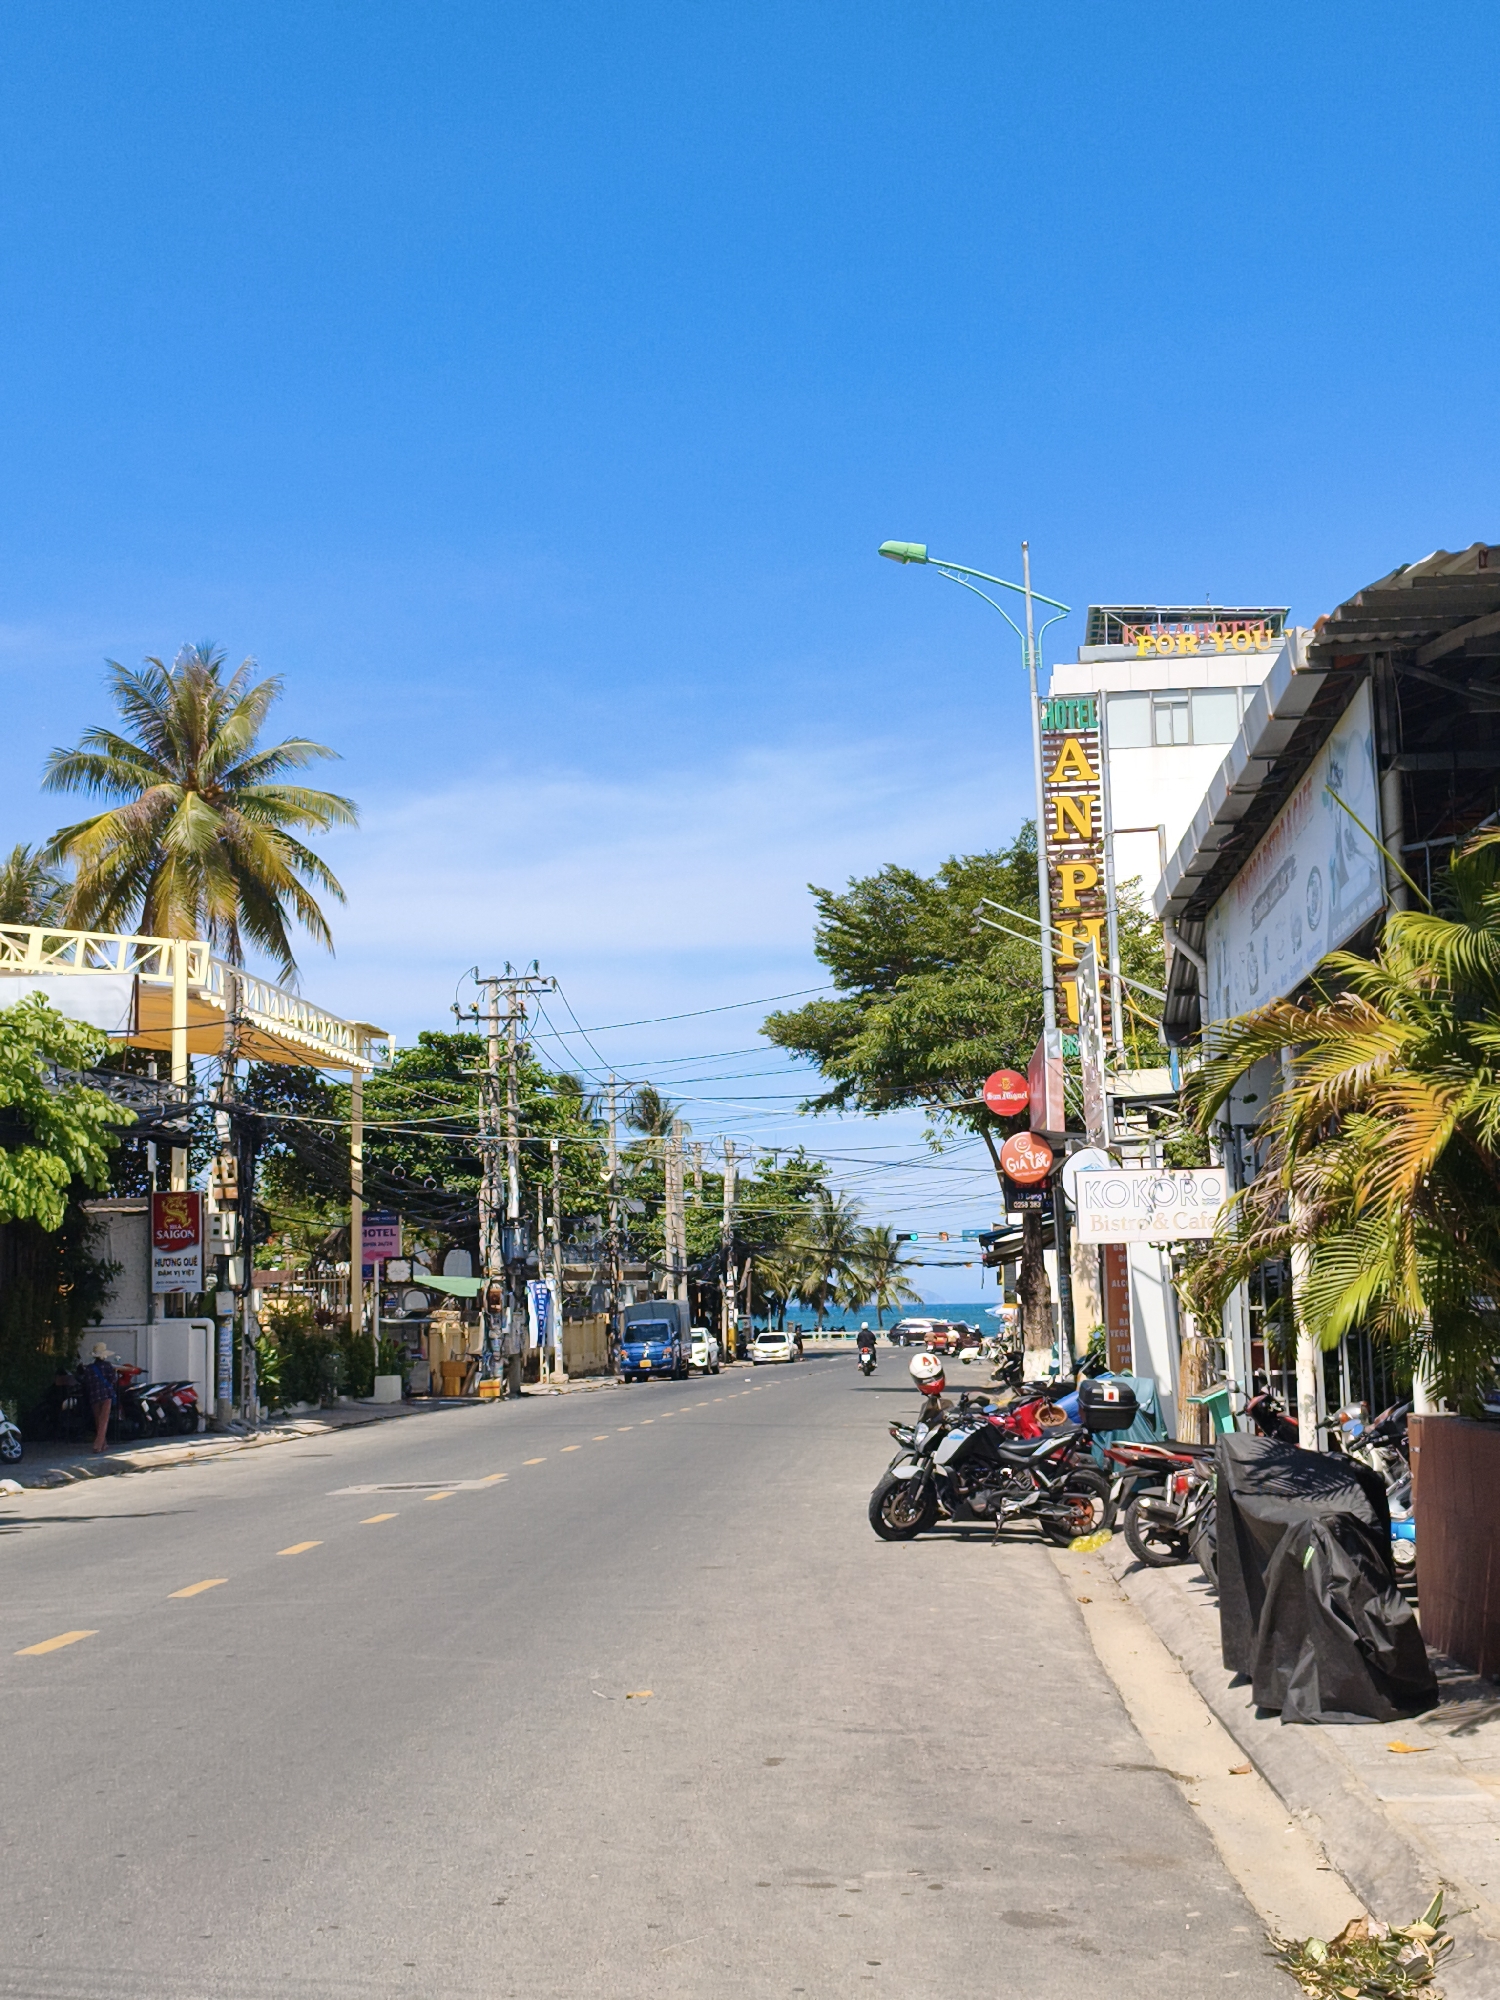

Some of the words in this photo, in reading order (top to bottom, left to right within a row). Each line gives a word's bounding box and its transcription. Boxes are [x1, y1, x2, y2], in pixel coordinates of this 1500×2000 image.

[1136, 634, 1200, 656] FOR
[1209, 629, 1273, 653] YOU
[1041, 699, 1099, 730] HOTEL
[1001, 1090, 1028, 1101] Miguel
[1090, 1214, 1149, 1232] Bistro
[1152, 1212, 1170, 1230] &
[156, 1229, 195, 1240] SAIGON
